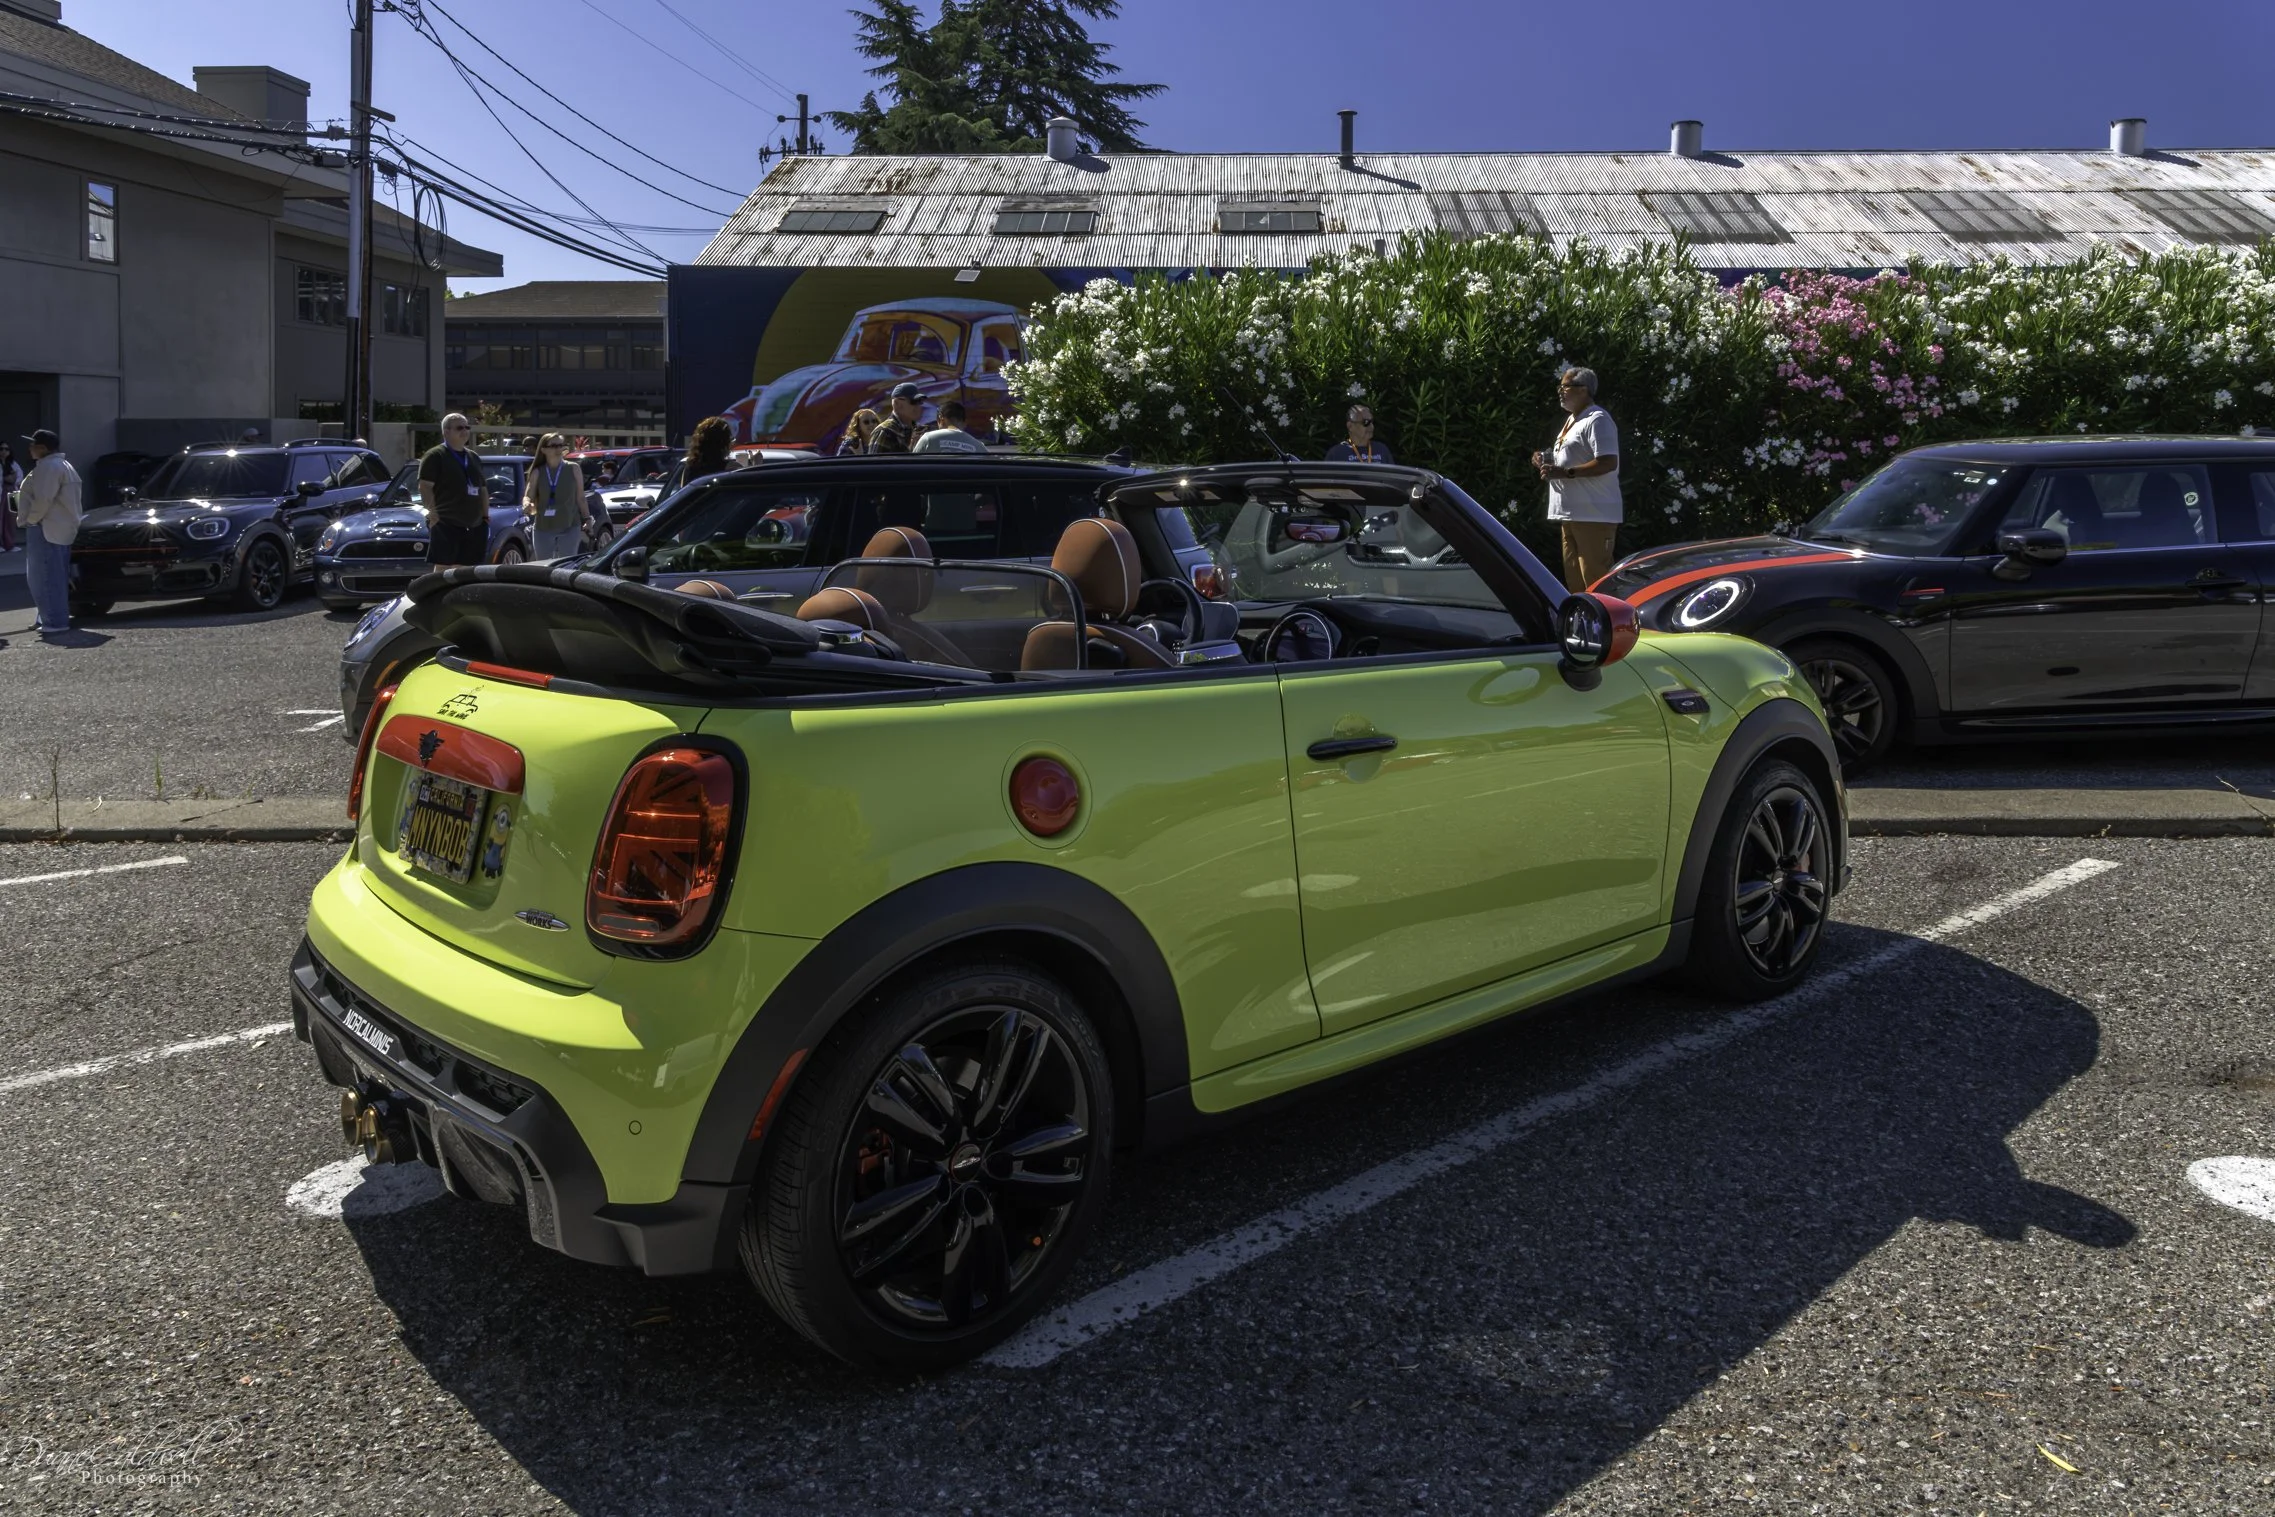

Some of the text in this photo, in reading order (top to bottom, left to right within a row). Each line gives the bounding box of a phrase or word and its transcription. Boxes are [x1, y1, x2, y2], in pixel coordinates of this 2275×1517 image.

[407, 805, 471, 864] MNYNBOB
[526, 914, 552, 930] WORKS
[342, 1008, 394, 1055] NORCALMINIS
